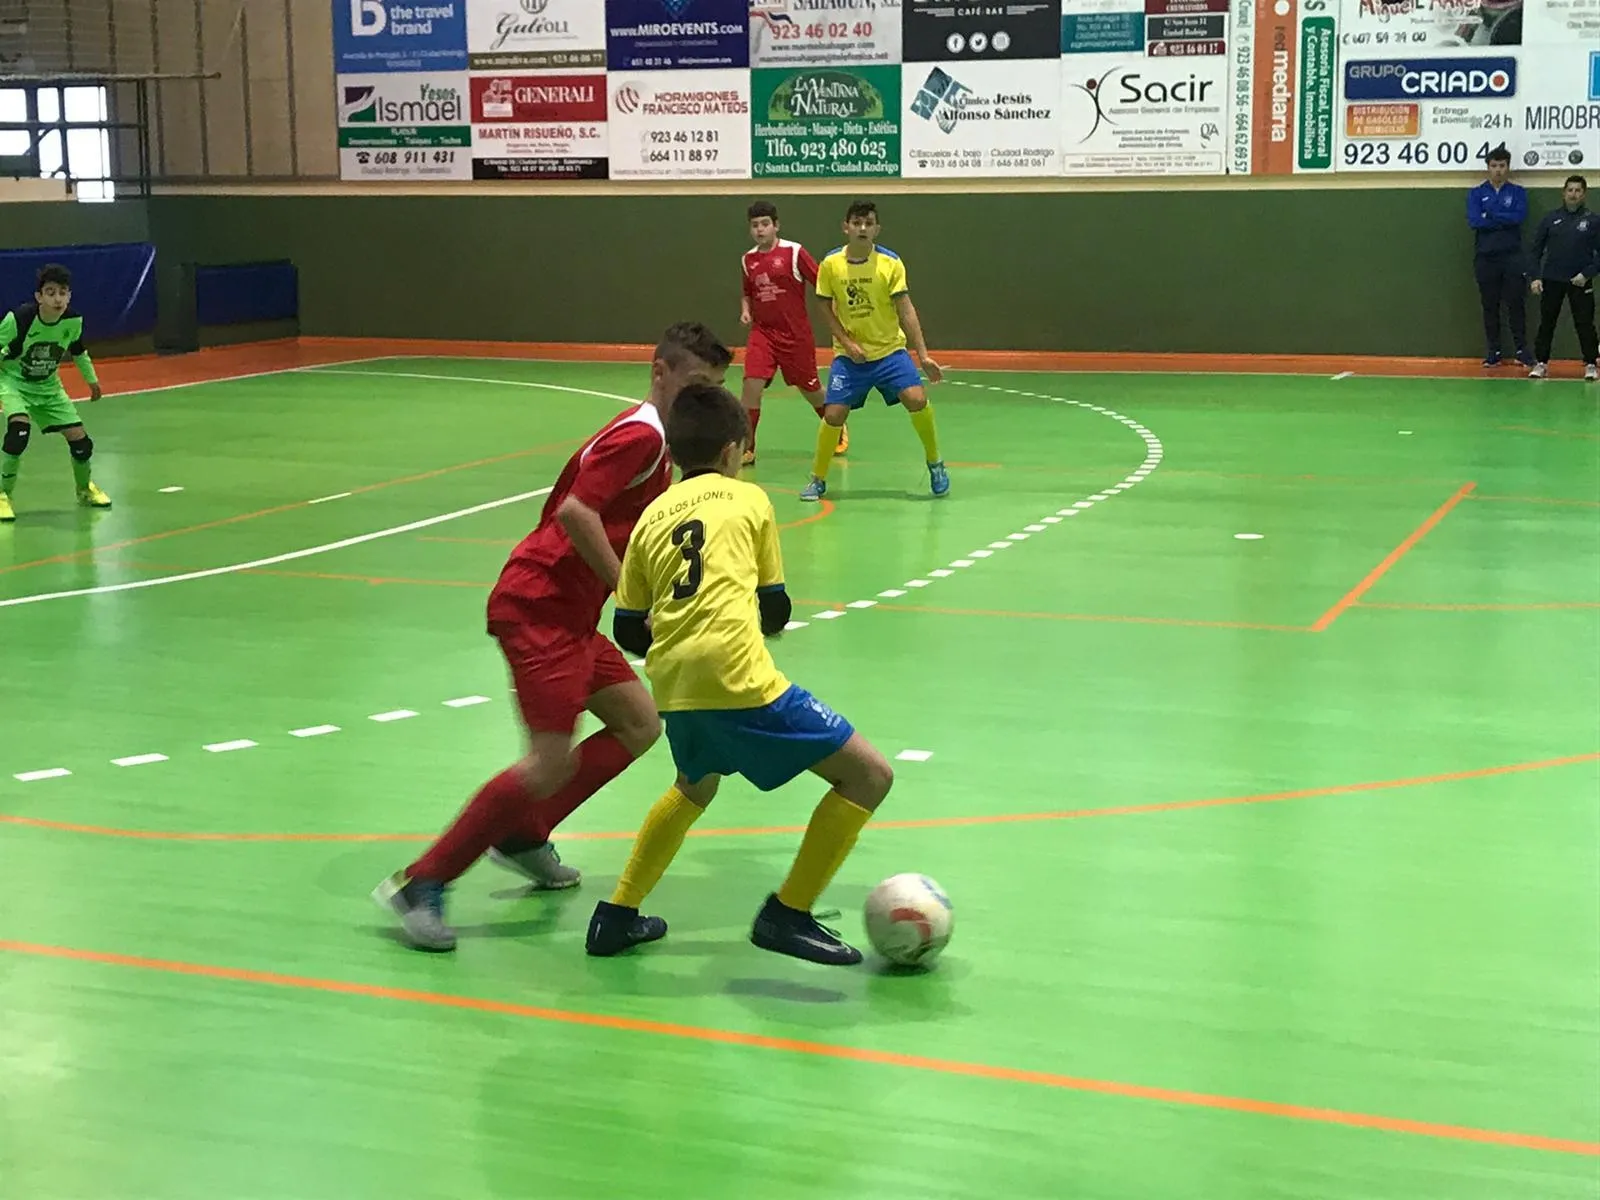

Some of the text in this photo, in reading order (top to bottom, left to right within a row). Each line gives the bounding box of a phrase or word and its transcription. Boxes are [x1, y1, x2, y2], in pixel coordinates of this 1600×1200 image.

[390, 4, 455, 20] the travel
[391, 21, 432, 35] brand
[772, 21, 873, 40] 923 46 02 40
[1305, 26, 1316, 34] y
[1350, 64, 1407, 79] GRUPO
[1120, 74, 1213, 103] Sacir
[1401, 70, 1511, 94] CRIADO
[421, 84, 456, 101] Yesos
[515, 86, 595, 104] GENERALI
[655, 90, 739, 102] HORMIGONES
[992, 92, 1032, 105] Jesús
[379, 95, 462, 122] Ismael
[643, 101, 749, 115] FRANCISCO MATEOS
[943, 107, 1051, 121] Alfonso Sánchez
[1432, 107, 1469, 116] Entrega
[1525, 105, 1600, 130] MIROBR
[579, 127, 601, 138] S.C.
[650, 130, 719, 143] 923 46 12 81
[1317, 115, 1329, 158] Laboral
[650, 149, 719, 162] 664 11 88 97
[765, 138, 886, 160] Tlfo. 923 480 625
[1345, 143, 1390, 165] 923
[1398, 142, 1429, 165] 46
[1438, 142, 1468, 164] 00
[374, 151, 455, 164] 608 911 431
[765, 161, 789, 173] Santa
[791, 160, 814, 173] Clara
[831, 160, 861, 172] Ciudad
[863, 160, 899, 174] Rodrigo
[669, 500, 688, 516] LOS
[691, 490, 734, 507] LEONES
[672, 519, 705, 600] 3
